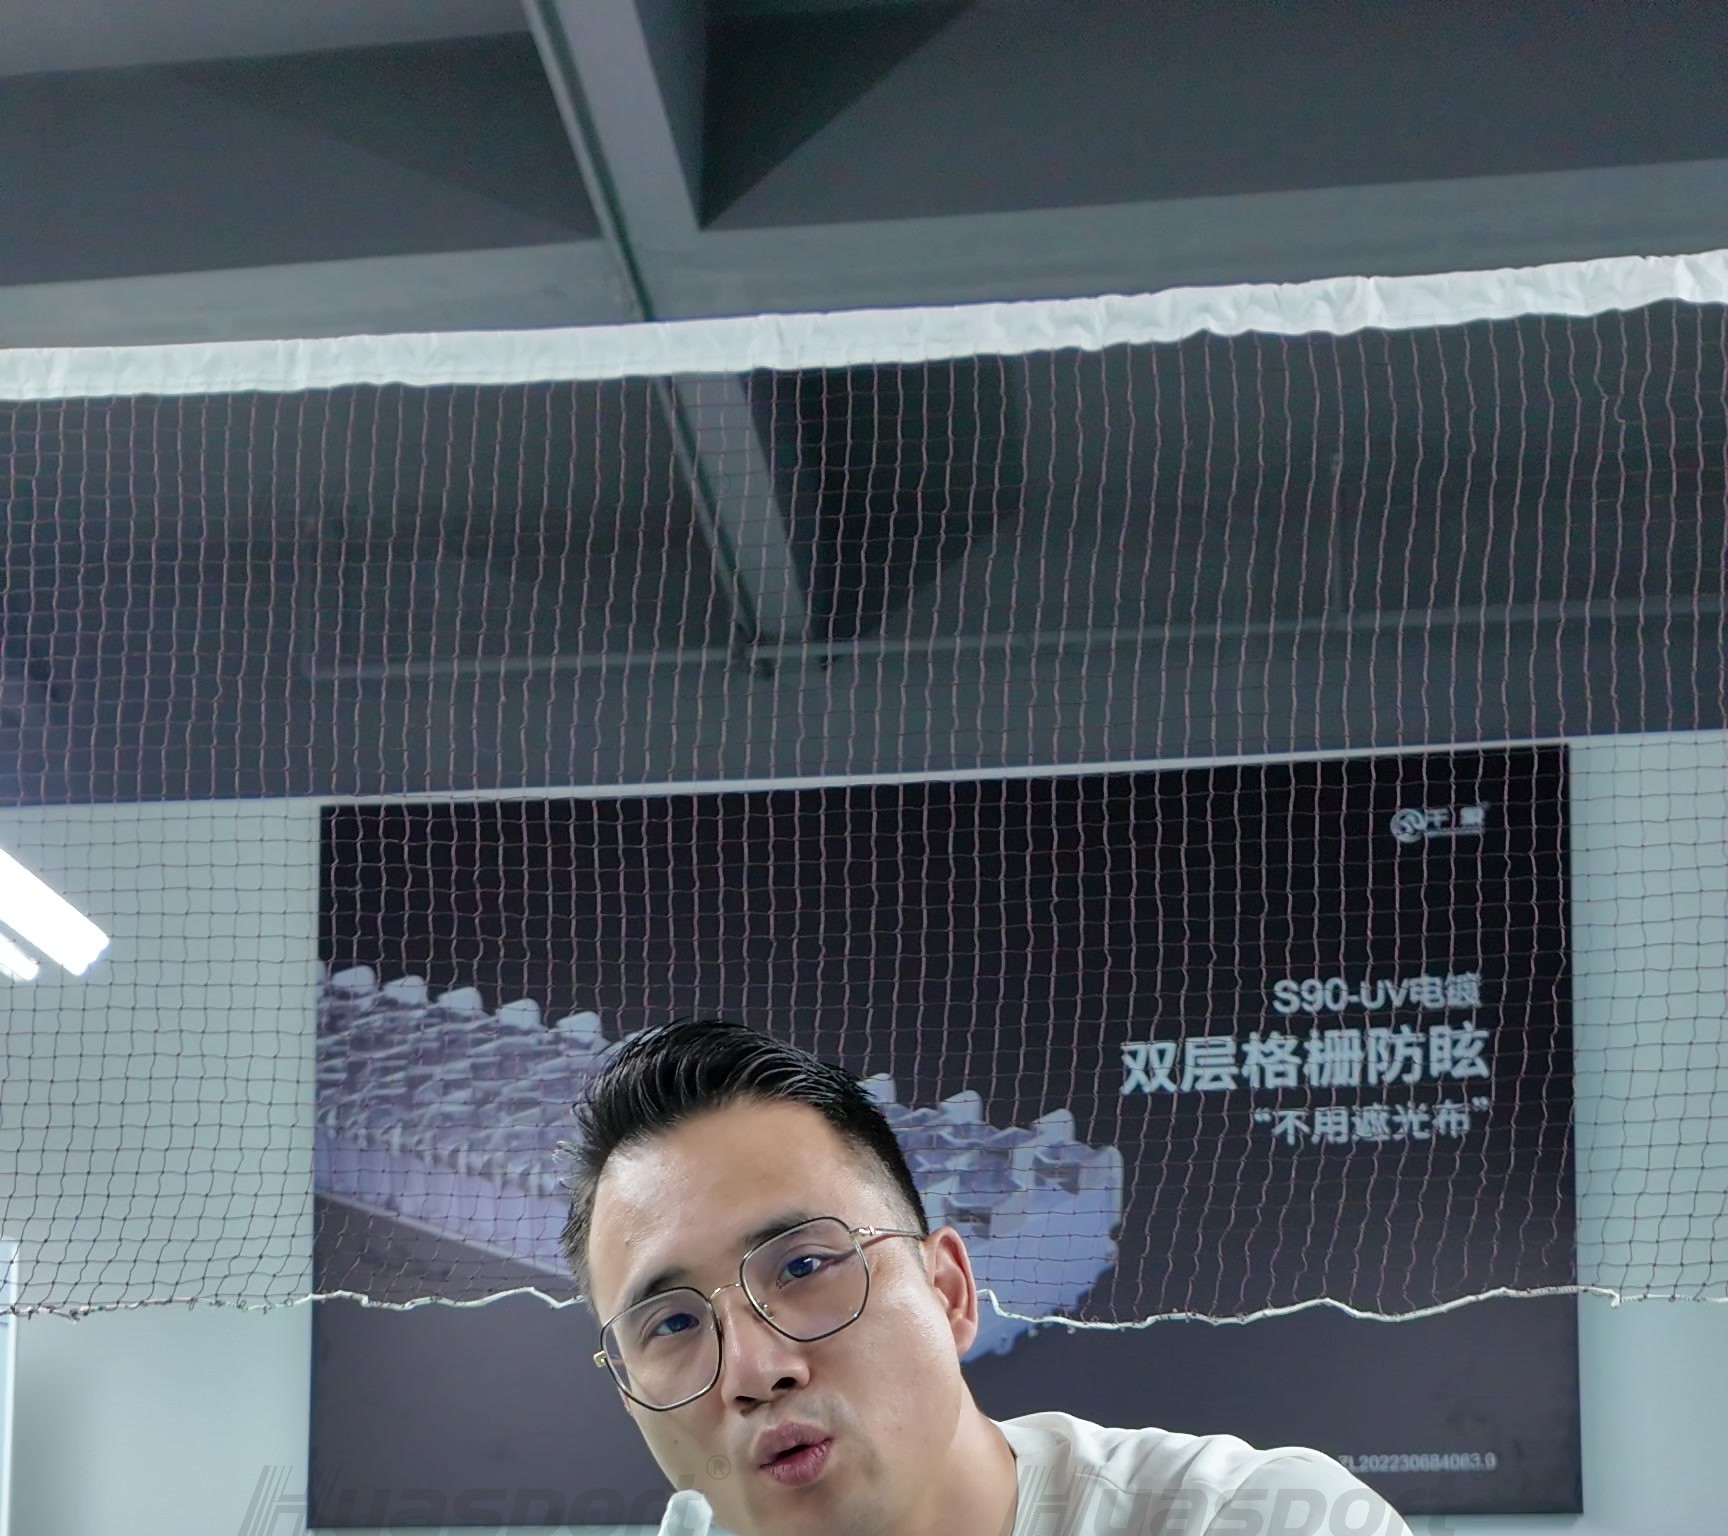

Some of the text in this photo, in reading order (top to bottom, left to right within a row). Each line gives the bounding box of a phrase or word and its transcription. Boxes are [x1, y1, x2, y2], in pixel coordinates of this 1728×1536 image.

[1272, 972, 1482, 1014] S90-UV电镀
[1120, 1021, 1490, 1095] 双层格栅防眩
